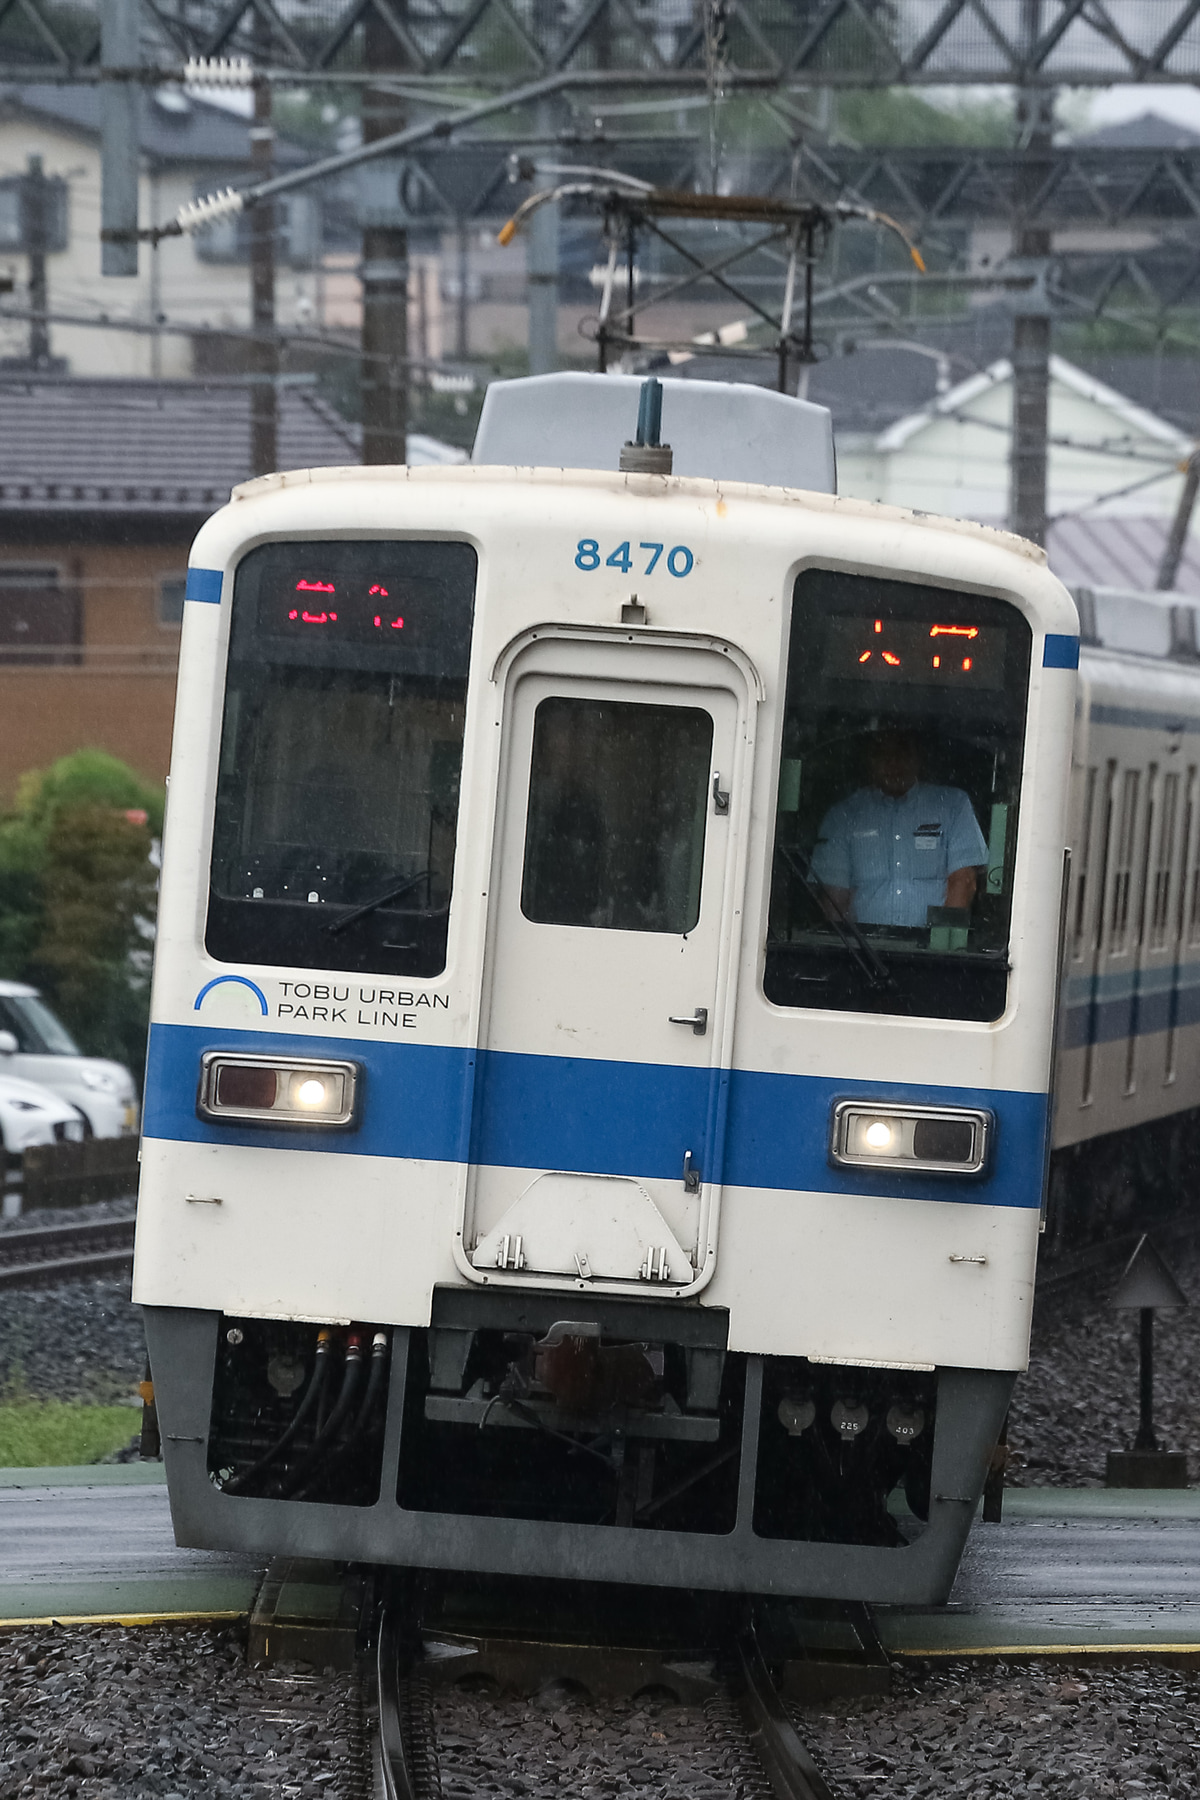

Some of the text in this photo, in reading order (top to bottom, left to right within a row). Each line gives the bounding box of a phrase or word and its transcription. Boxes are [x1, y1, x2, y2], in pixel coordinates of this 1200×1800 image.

[574, 538, 694, 578] 8470
[278, 982, 450, 1009] TOBU URBAN
[277, 1003, 418, 1029] PARK LINE
[840, 1421, 859, 1431] 225
